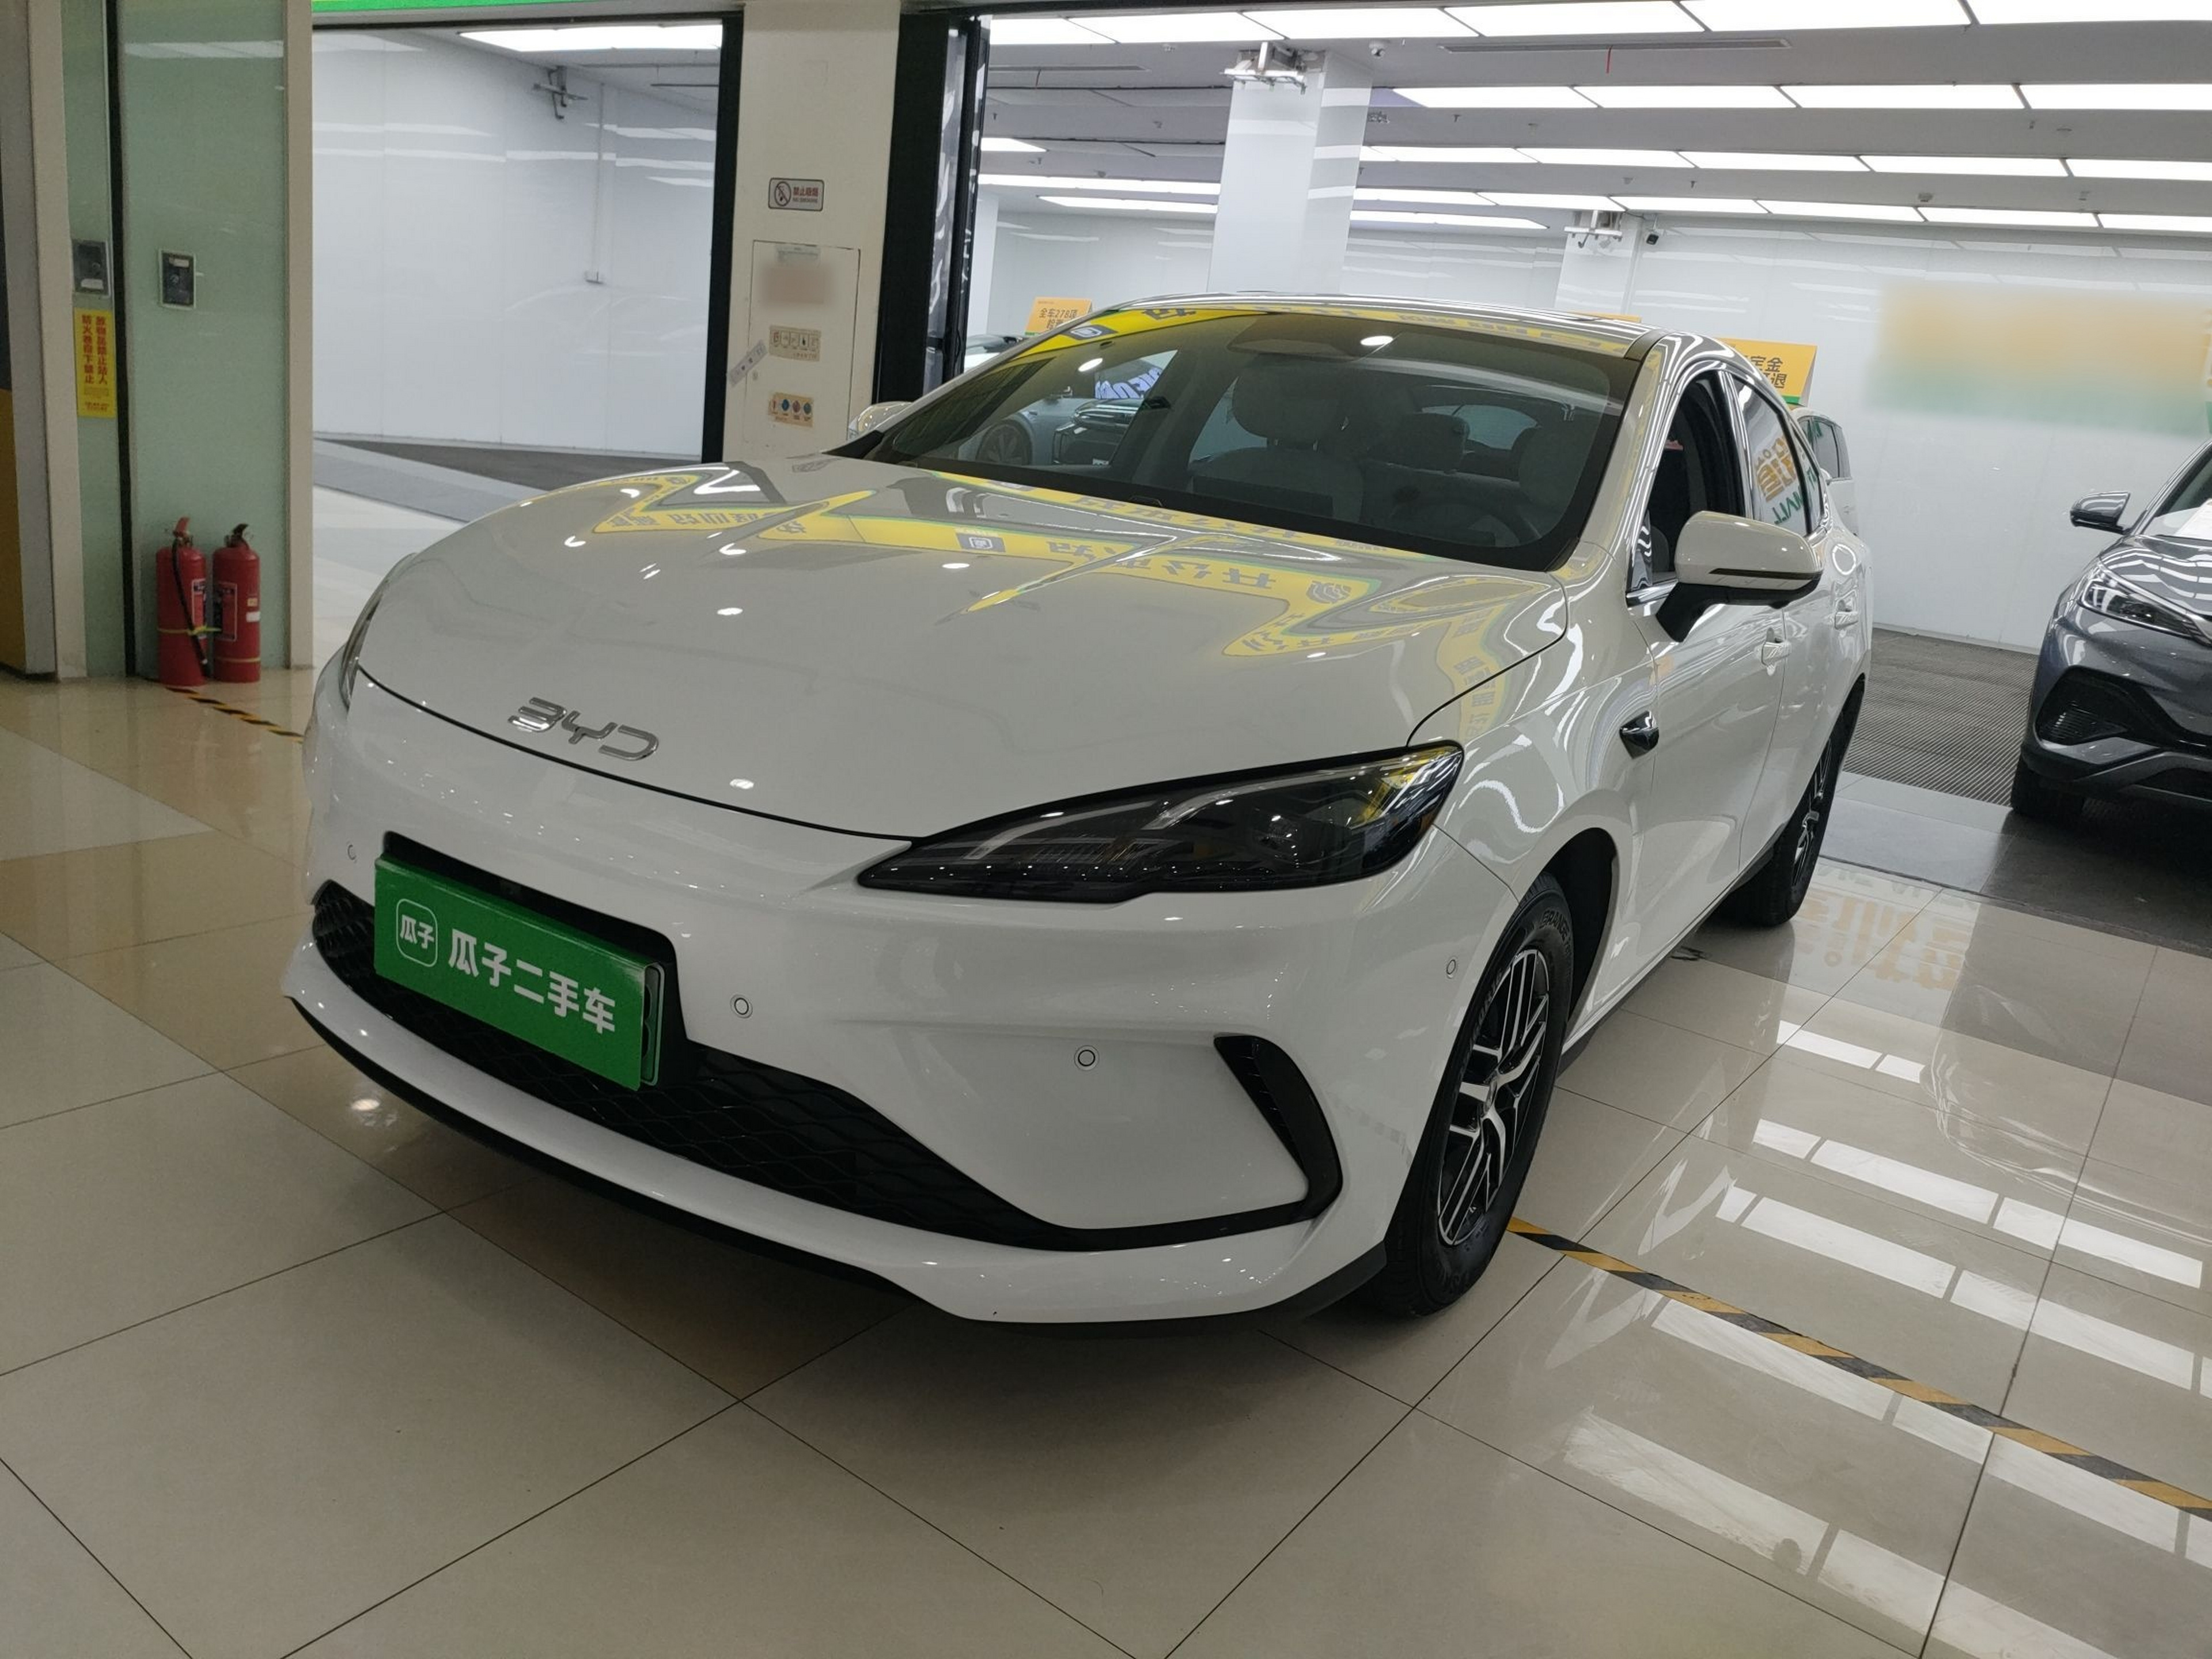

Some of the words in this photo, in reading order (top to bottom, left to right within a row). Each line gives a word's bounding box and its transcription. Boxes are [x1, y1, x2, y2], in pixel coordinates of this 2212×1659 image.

[1039, 308, 1078, 319] 全车278项
[507, 697, 659, 761] BYD
[399, 915, 435, 949] 瓜子
[448, 928, 616, 1035] 瓜子二手车
